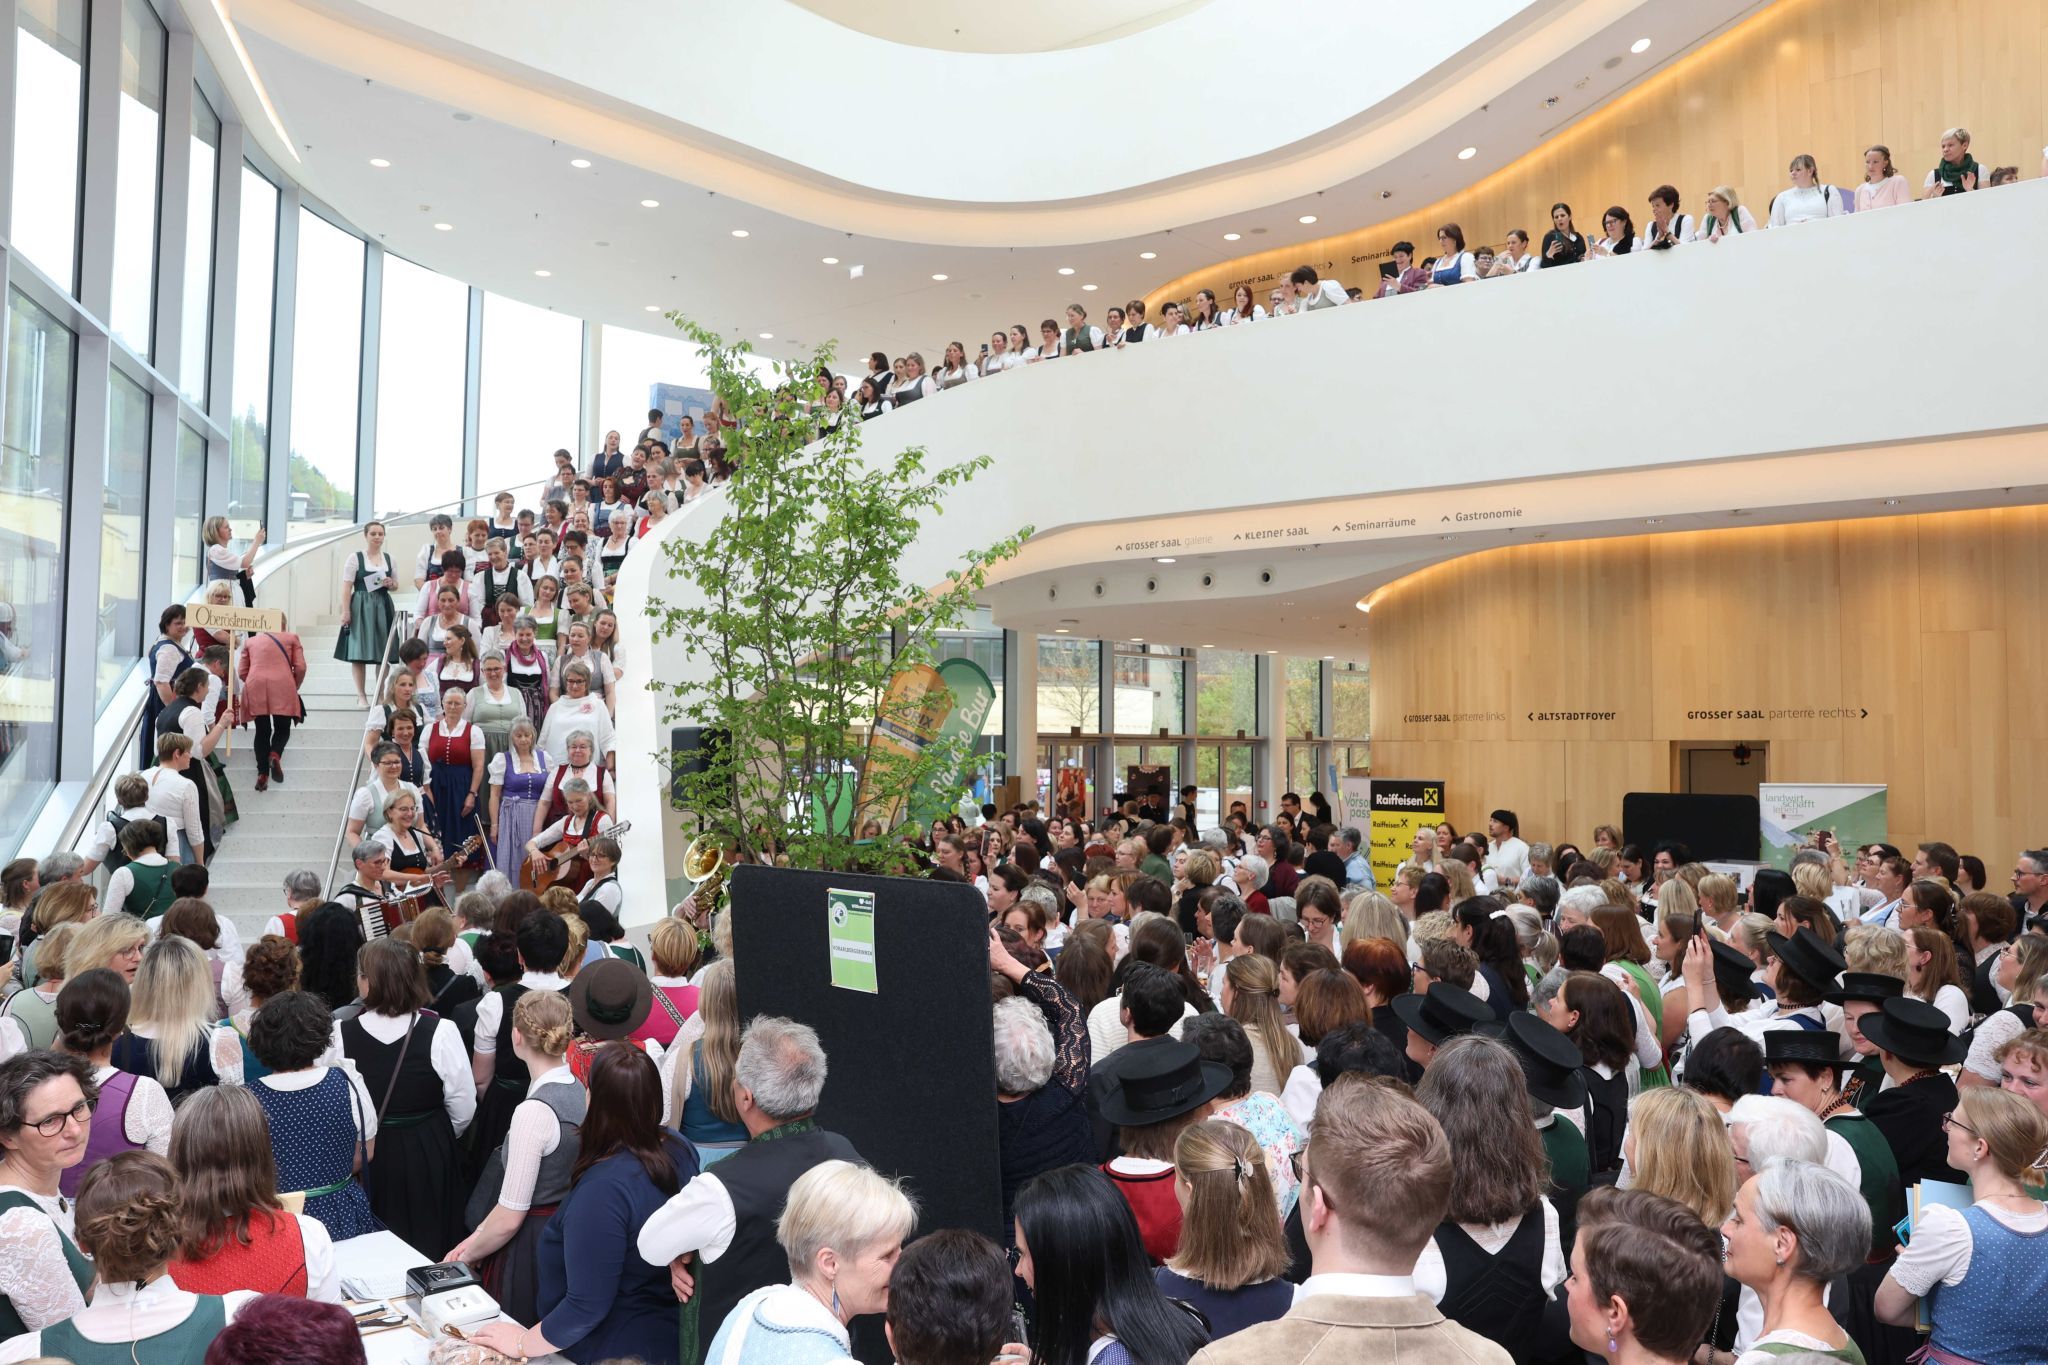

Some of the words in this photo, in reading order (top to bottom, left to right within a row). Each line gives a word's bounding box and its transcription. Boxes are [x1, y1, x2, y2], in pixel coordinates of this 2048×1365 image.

[1351, 248, 1393, 264] Seminarrä
[1455, 507, 1522, 522] Gastronomie
[1345, 517, 1416, 532] Seminarräume
[1184, 535, 1213, 548] galerie
[195, 606, 272, 630] Oberösterreich
[960, 686, 989, 730] Bur
[1769, 709, 1815, 721] parterre
[1818, 707, 1857, 719] rechts
[1453, 712, 1484, 723] parterre
[1485, 711, 1505, 721] links
[1376, 793, 1423, 806] Raiffeisen
[1372, 821, 1400, 829] Raiffeisen
